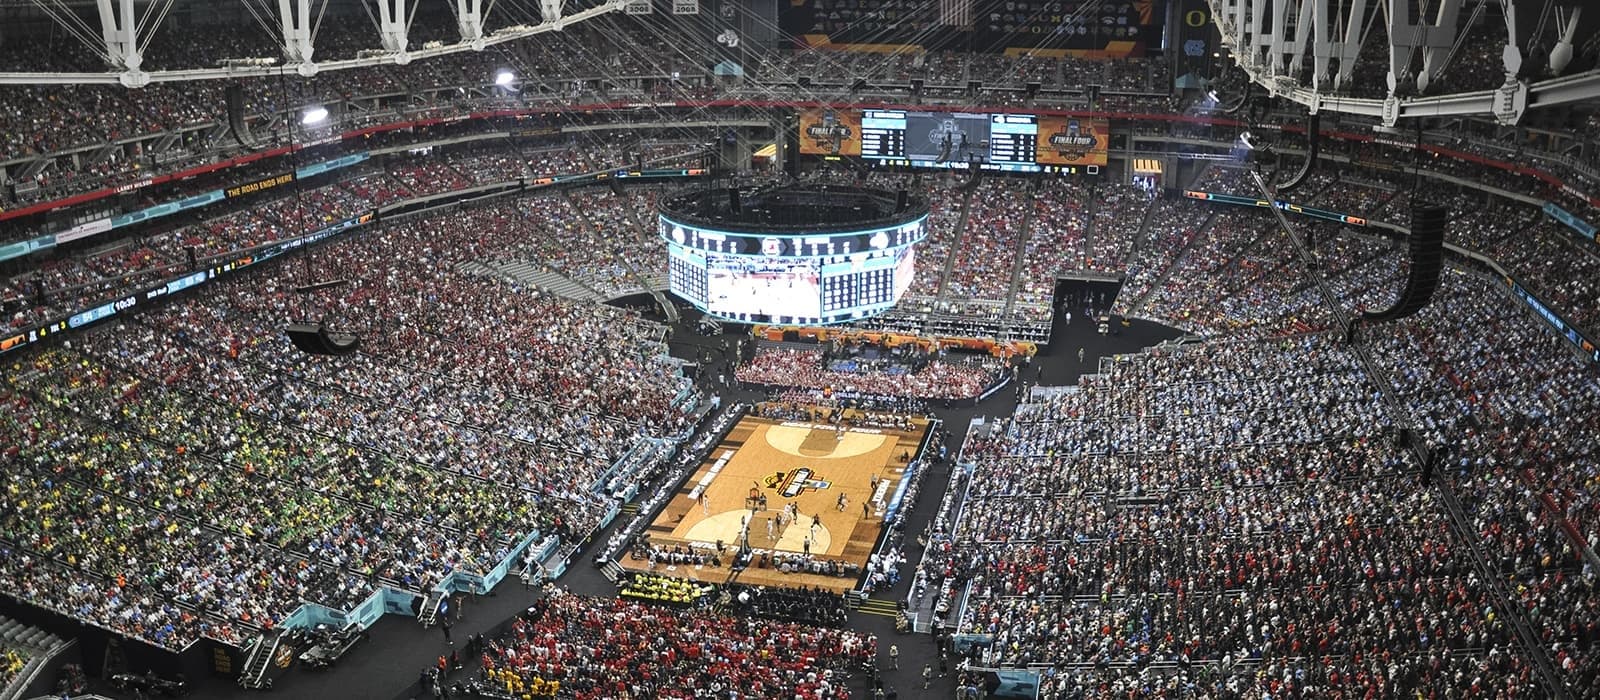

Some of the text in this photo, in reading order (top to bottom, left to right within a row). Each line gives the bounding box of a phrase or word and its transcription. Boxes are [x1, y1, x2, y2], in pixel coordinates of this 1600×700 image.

[1054, 136, 1092, 145] FINAL FOUR
[227, 174, 292, 197] THE ROAD ENDS HERE
[115, 296, 136, 310] 10:30
